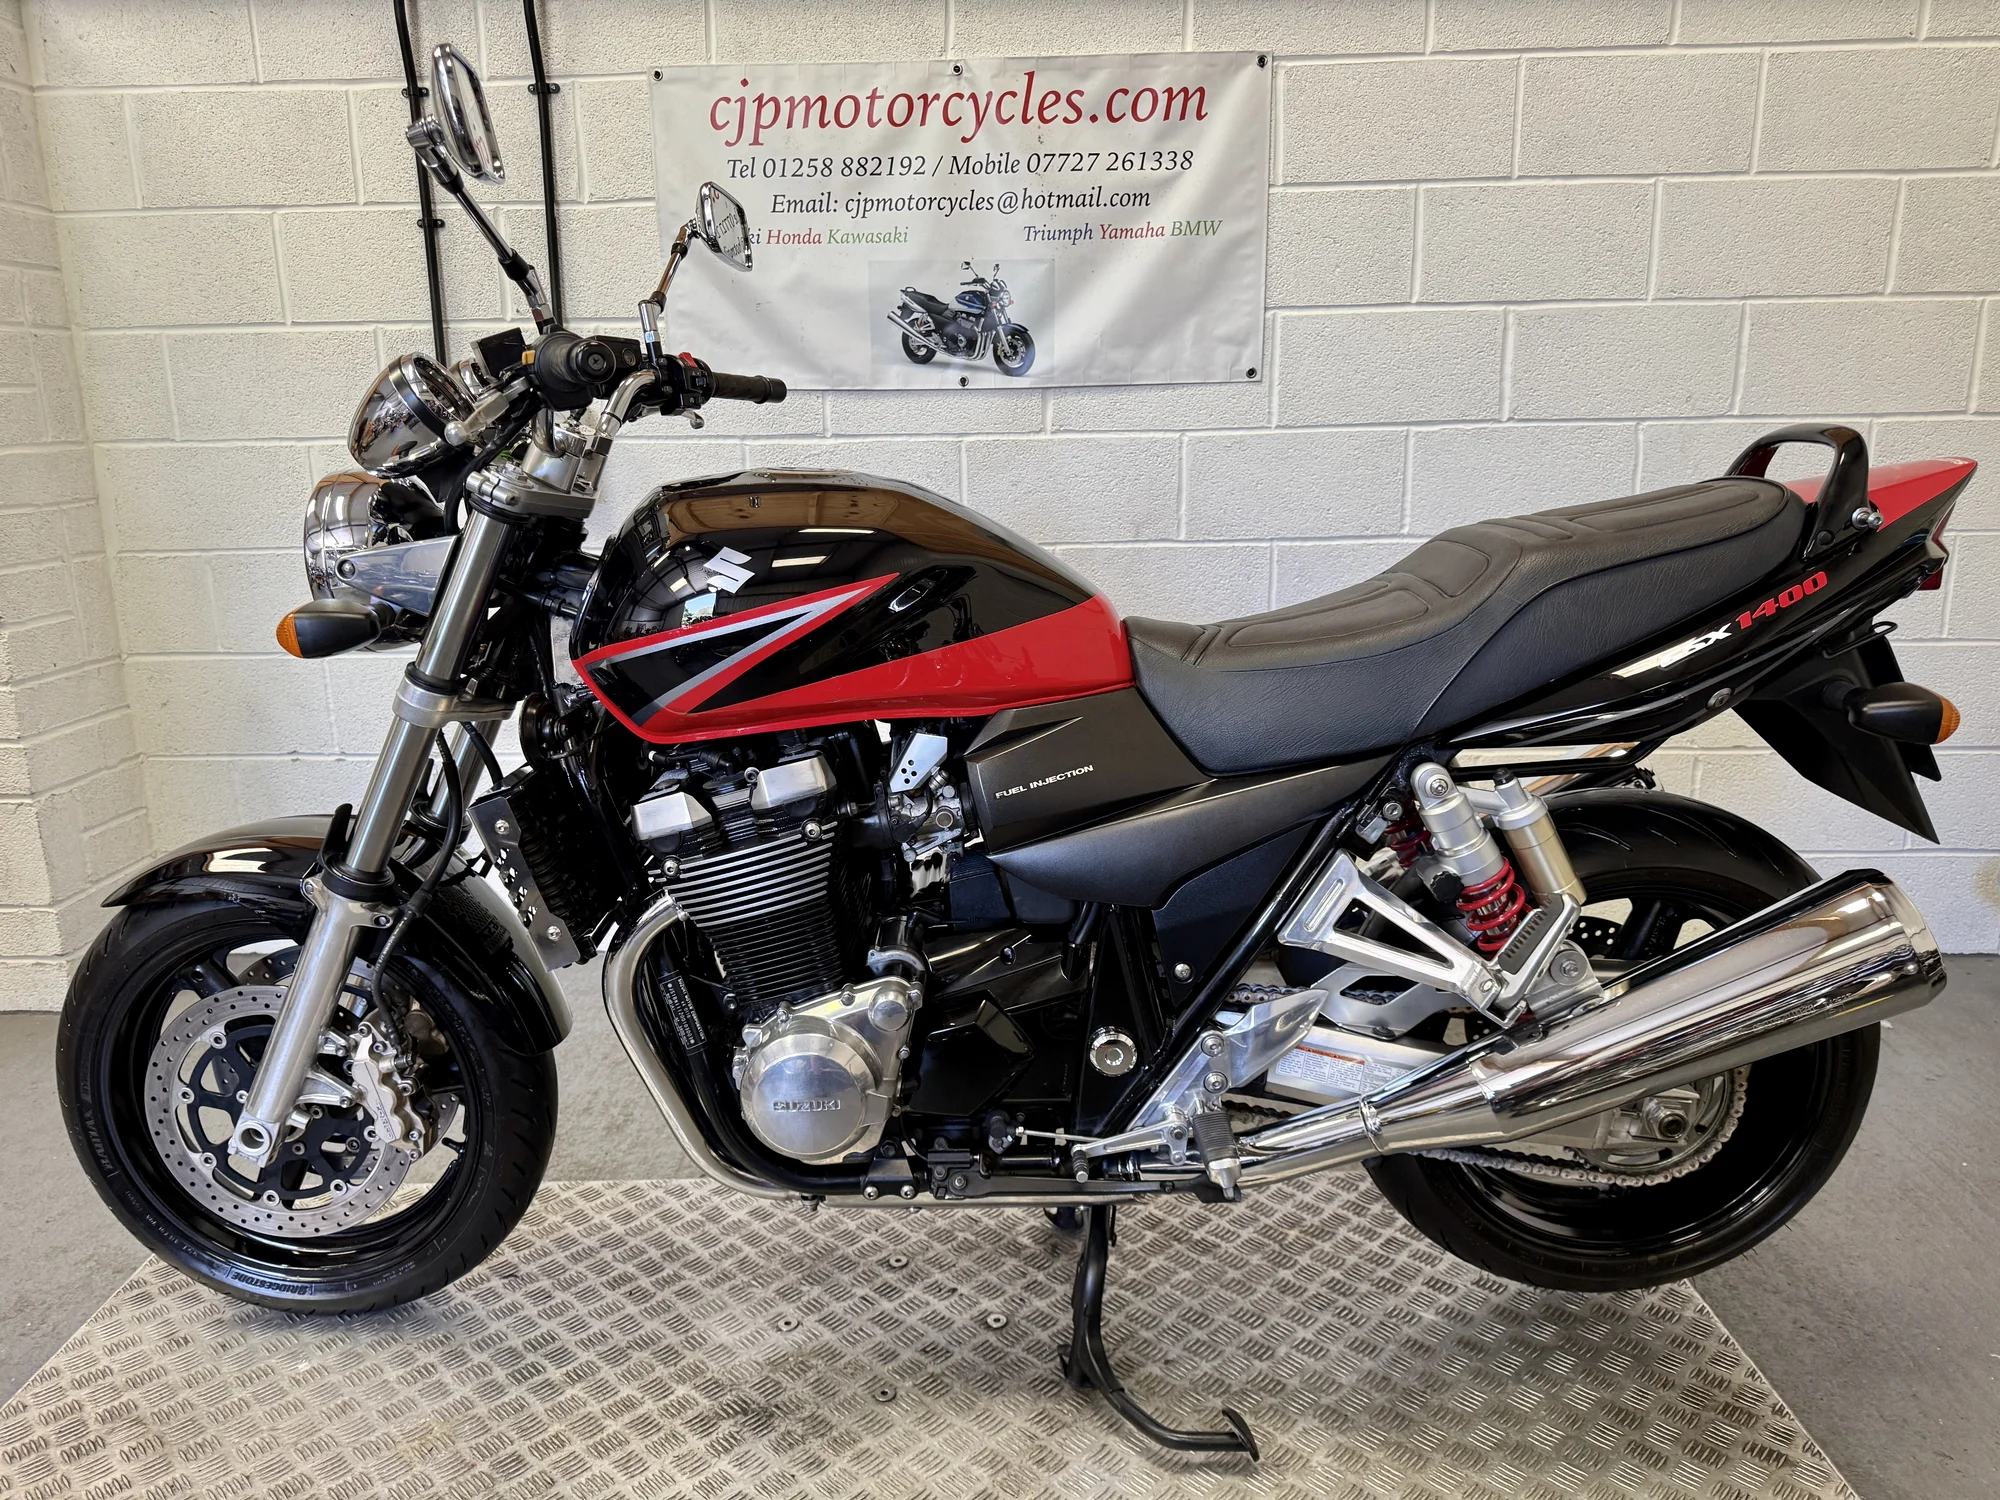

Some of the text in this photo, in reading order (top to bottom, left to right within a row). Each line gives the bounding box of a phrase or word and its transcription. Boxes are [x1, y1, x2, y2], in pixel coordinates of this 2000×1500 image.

[709, 71, 1208, 147] cjpmotorcycles.com
[727, 150, 1194, 179] Tel 01258 882192 / Mobile 07727 261338
[771, 186, 1151, 219] Email: cjpmotorcycles@hotmail.com
[766, 228, 822, 246] Honda
[827, 226, 909, 246] Kawasaki
[1023, 219, 1223, 246] Triumph Yamaha BMW
[1735, 571, 1828, 629] 1400
[995, 764, 1095, 799] FUEL INJECTION
[773, 1099, 841, 1112] SUZUKI
[231, 1270, 311, 1295] BRIDGESTONE
